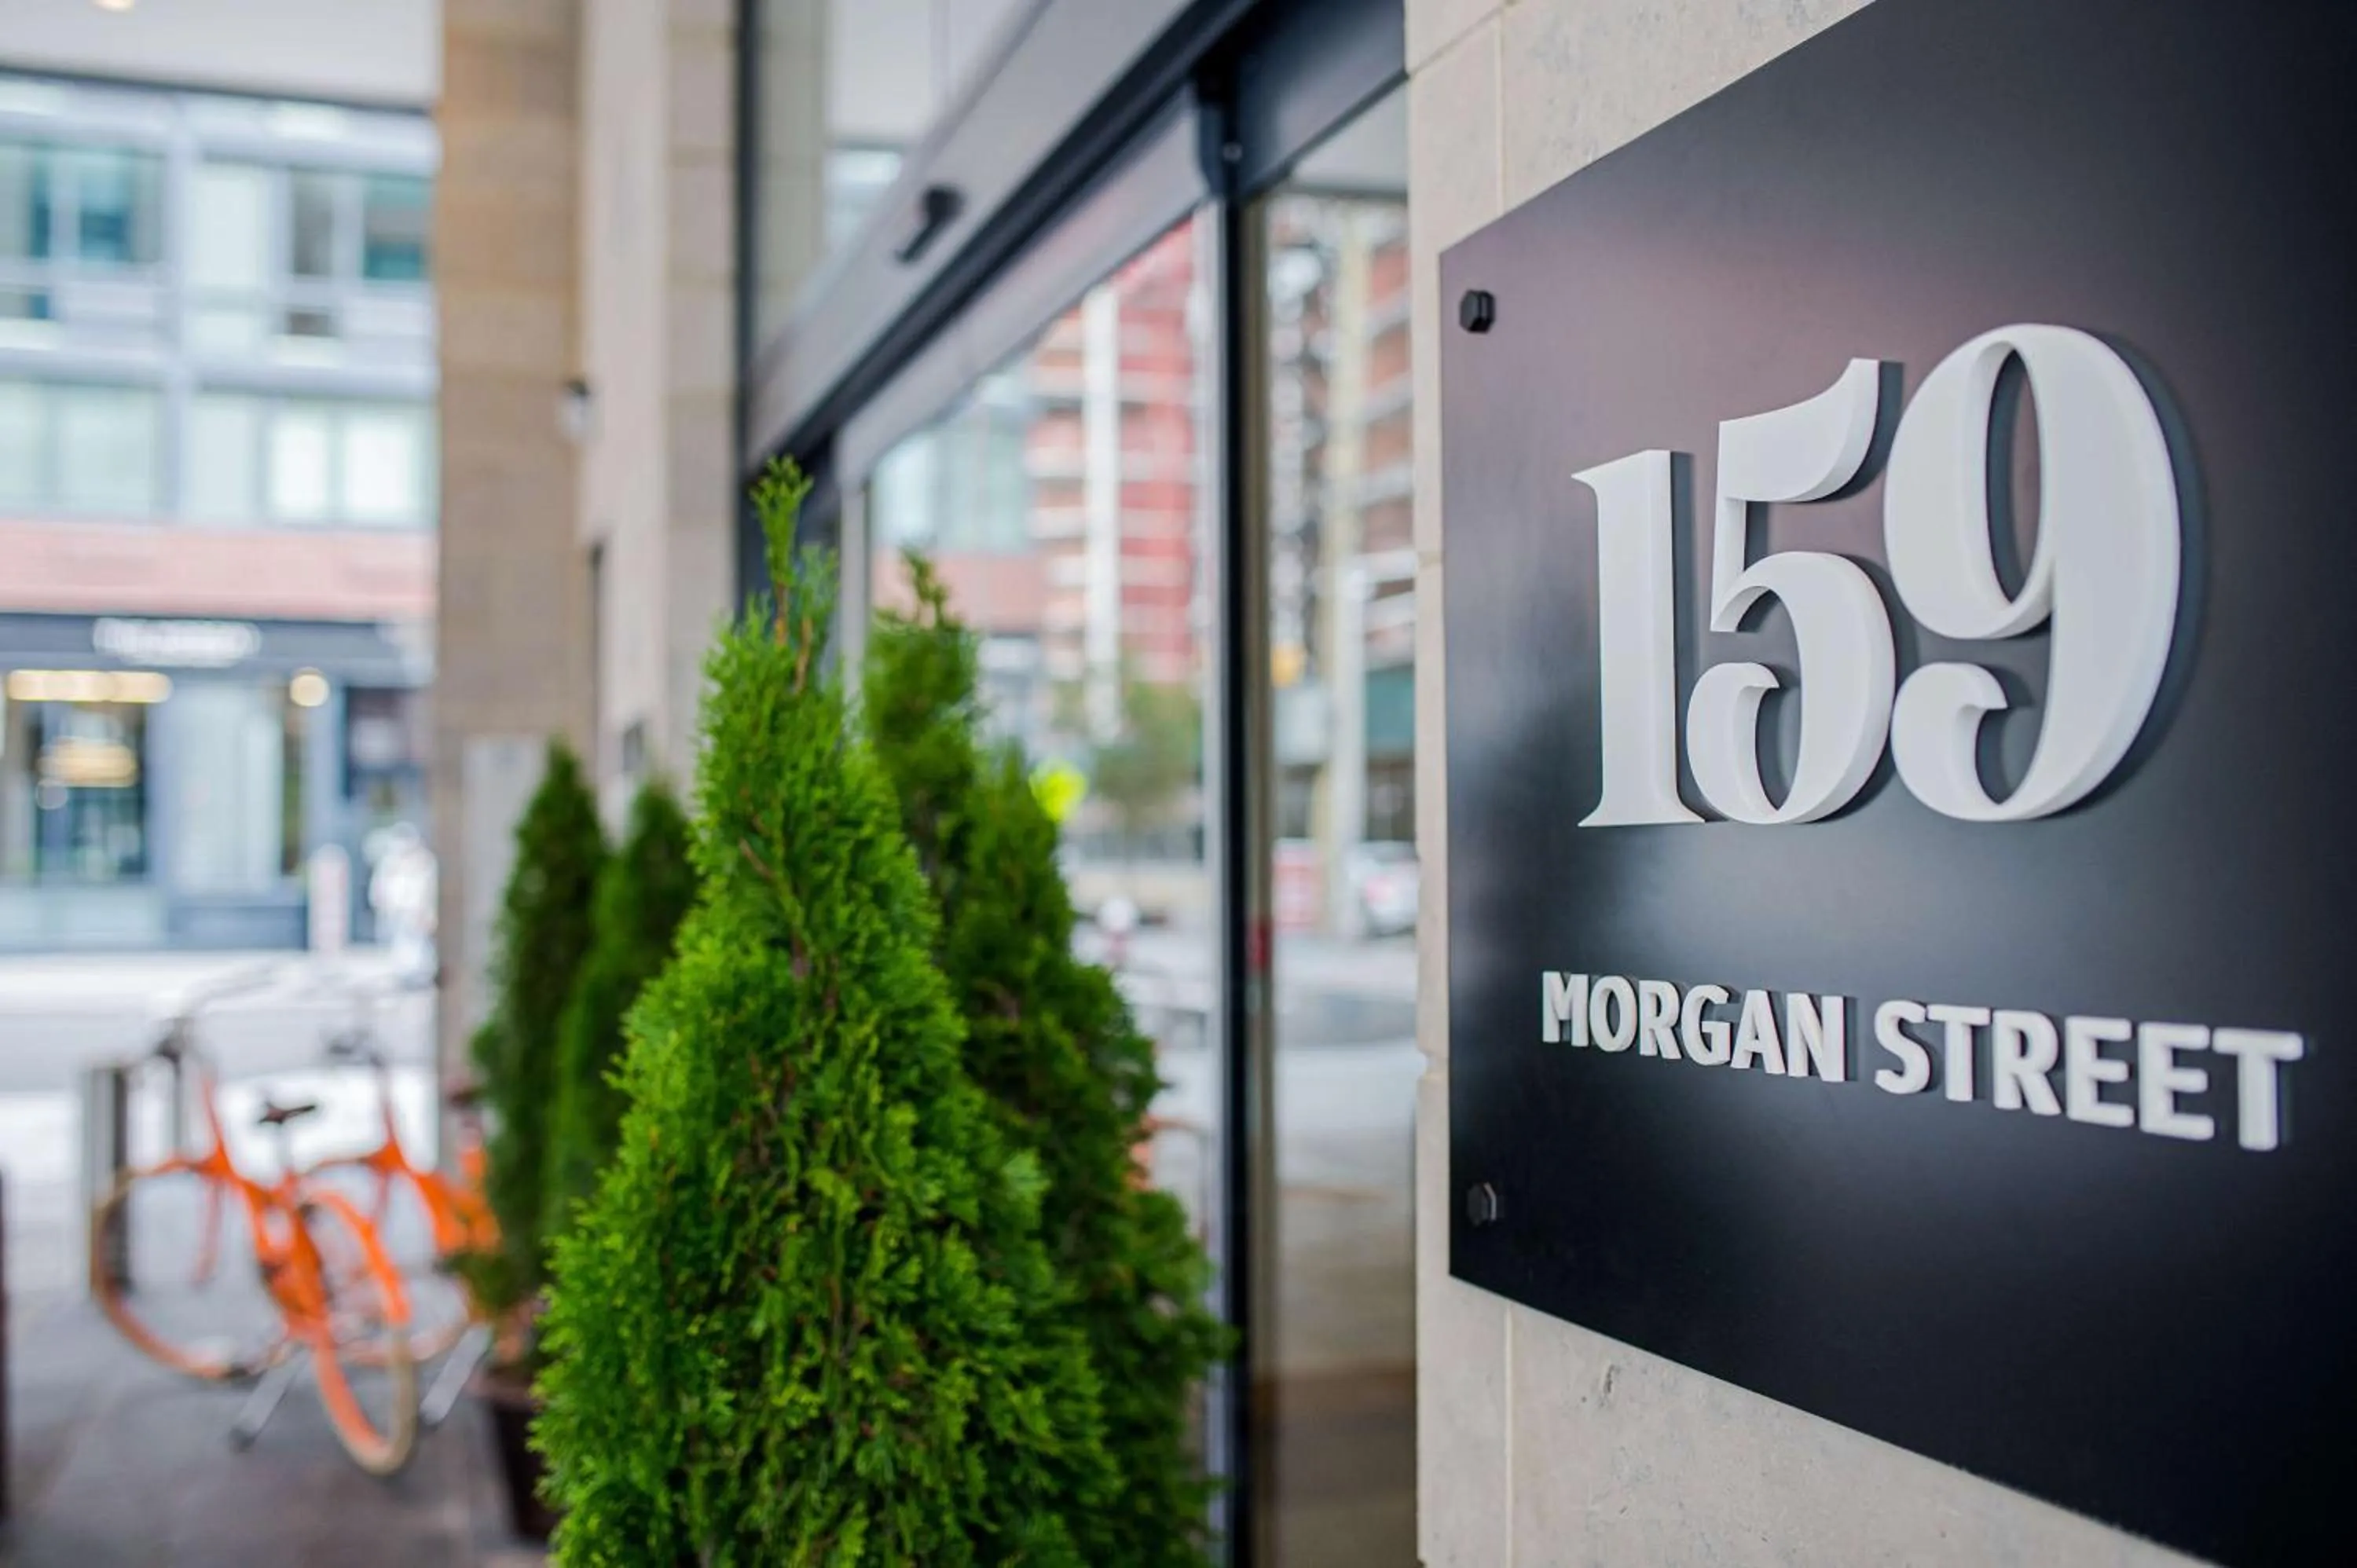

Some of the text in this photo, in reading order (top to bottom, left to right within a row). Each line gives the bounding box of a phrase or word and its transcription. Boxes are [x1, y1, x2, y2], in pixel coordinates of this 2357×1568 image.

[1571, 323, 2181, 827] 159
[1542, 971, 2304, 1151] MORGAN STREET
